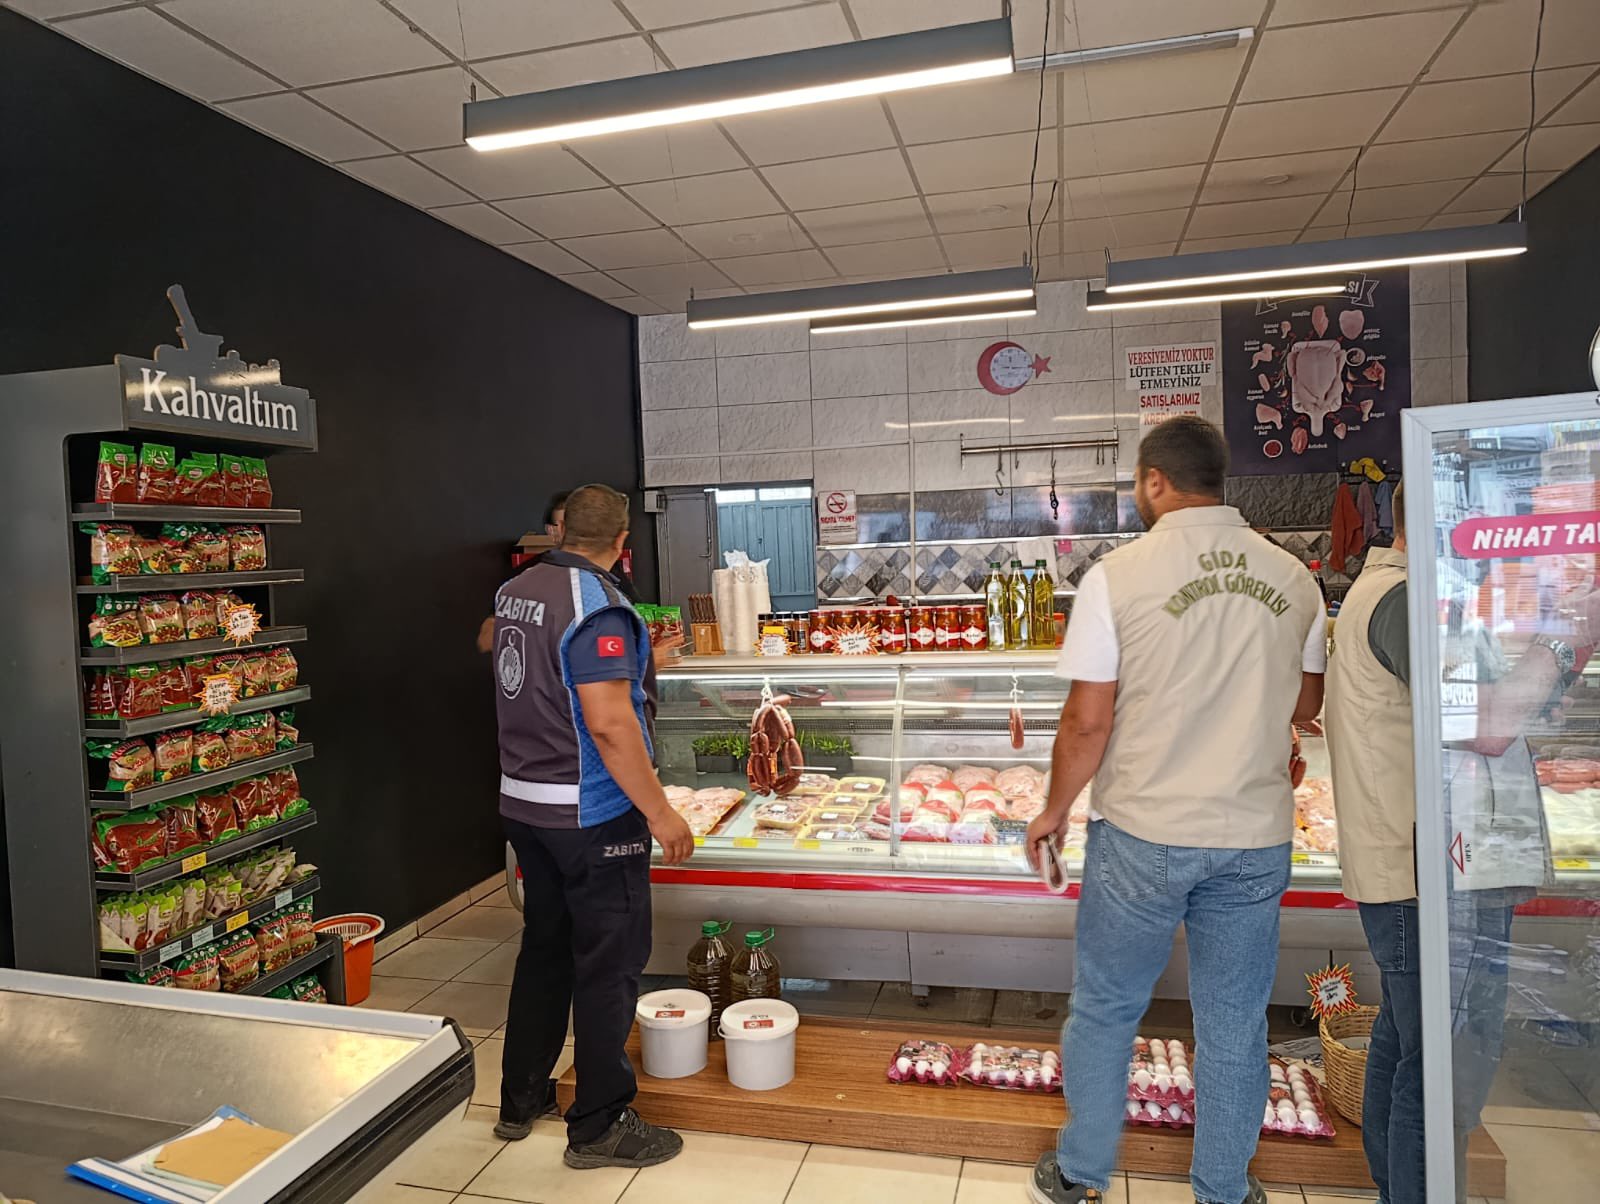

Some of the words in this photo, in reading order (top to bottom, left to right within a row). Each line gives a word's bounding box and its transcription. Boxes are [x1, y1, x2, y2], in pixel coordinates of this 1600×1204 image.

[1181, 347, 1214, 362] YOKTUR
[1129, 365, 1171, 378] LÜTFEN
[1172, 361, 1212, 375] TEKLİF
[1140, 375, 1201, 389] ETMEYİNİZ
[140, 367, 298, 431] Kahvaltım
[1198, 550, 1248, 572] GIDA
[1162, 574, 1223, 620] KONTROL
[495, 595, 546, 627] ZABITA
[604, 842, 646, 857] ZABITA
